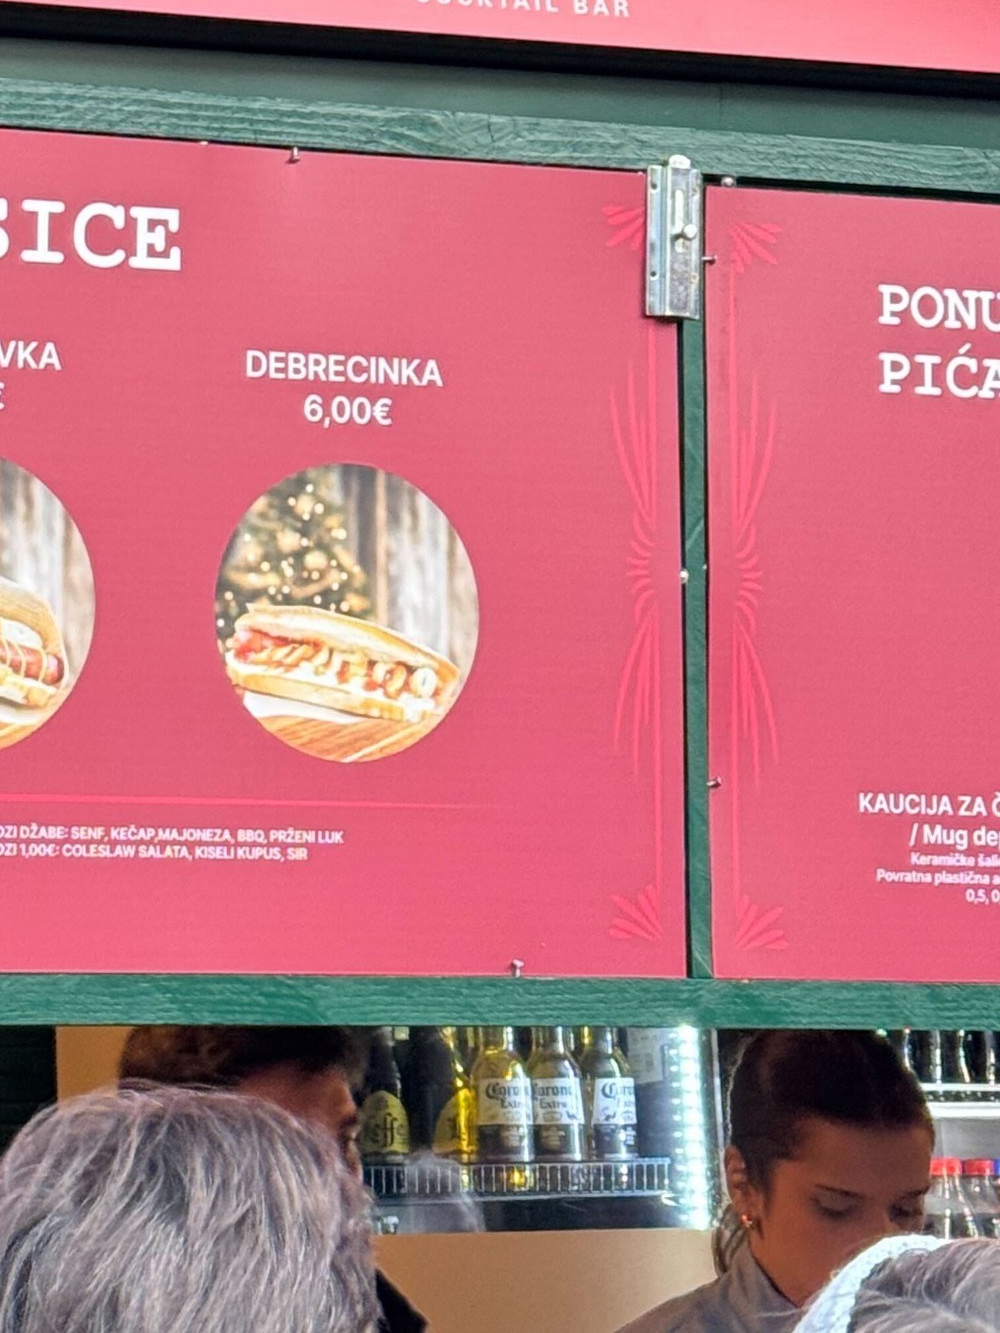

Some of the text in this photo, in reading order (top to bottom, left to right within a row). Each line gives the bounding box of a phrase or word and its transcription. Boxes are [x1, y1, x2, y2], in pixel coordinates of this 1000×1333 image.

[245, 349, 444, 387] DEBRECINKA
[303, 394, 393, 429] 6,00€
[859, 792, 954, 816] KAUCIJA
[957, 795, 988, 817] ZA
[20, 821, 69, 840] DŽABE:
[70, 826, 109, 842] SENF,
[237, 829, 268, 844] BBQ,
[270, 826, 315, 843] PRŽENI
[317, 830, 344, 844] LUK
[922, 823, 969, 850] Mug
[972, 825, 1000, 850] de
[61, 844, 136, 858] COLESLAW
[138, 844, 193, 861] SALATA,
[195, 845, 235, 859] KISELI
[237, 846, 285, 862] KUPUS,
[286, 847, 308, 860] SIR
[910, 852, 975, 867] Keramičke
[876, 868, 932, 883] Povratna
[934, 869, 990, 886] plastična
